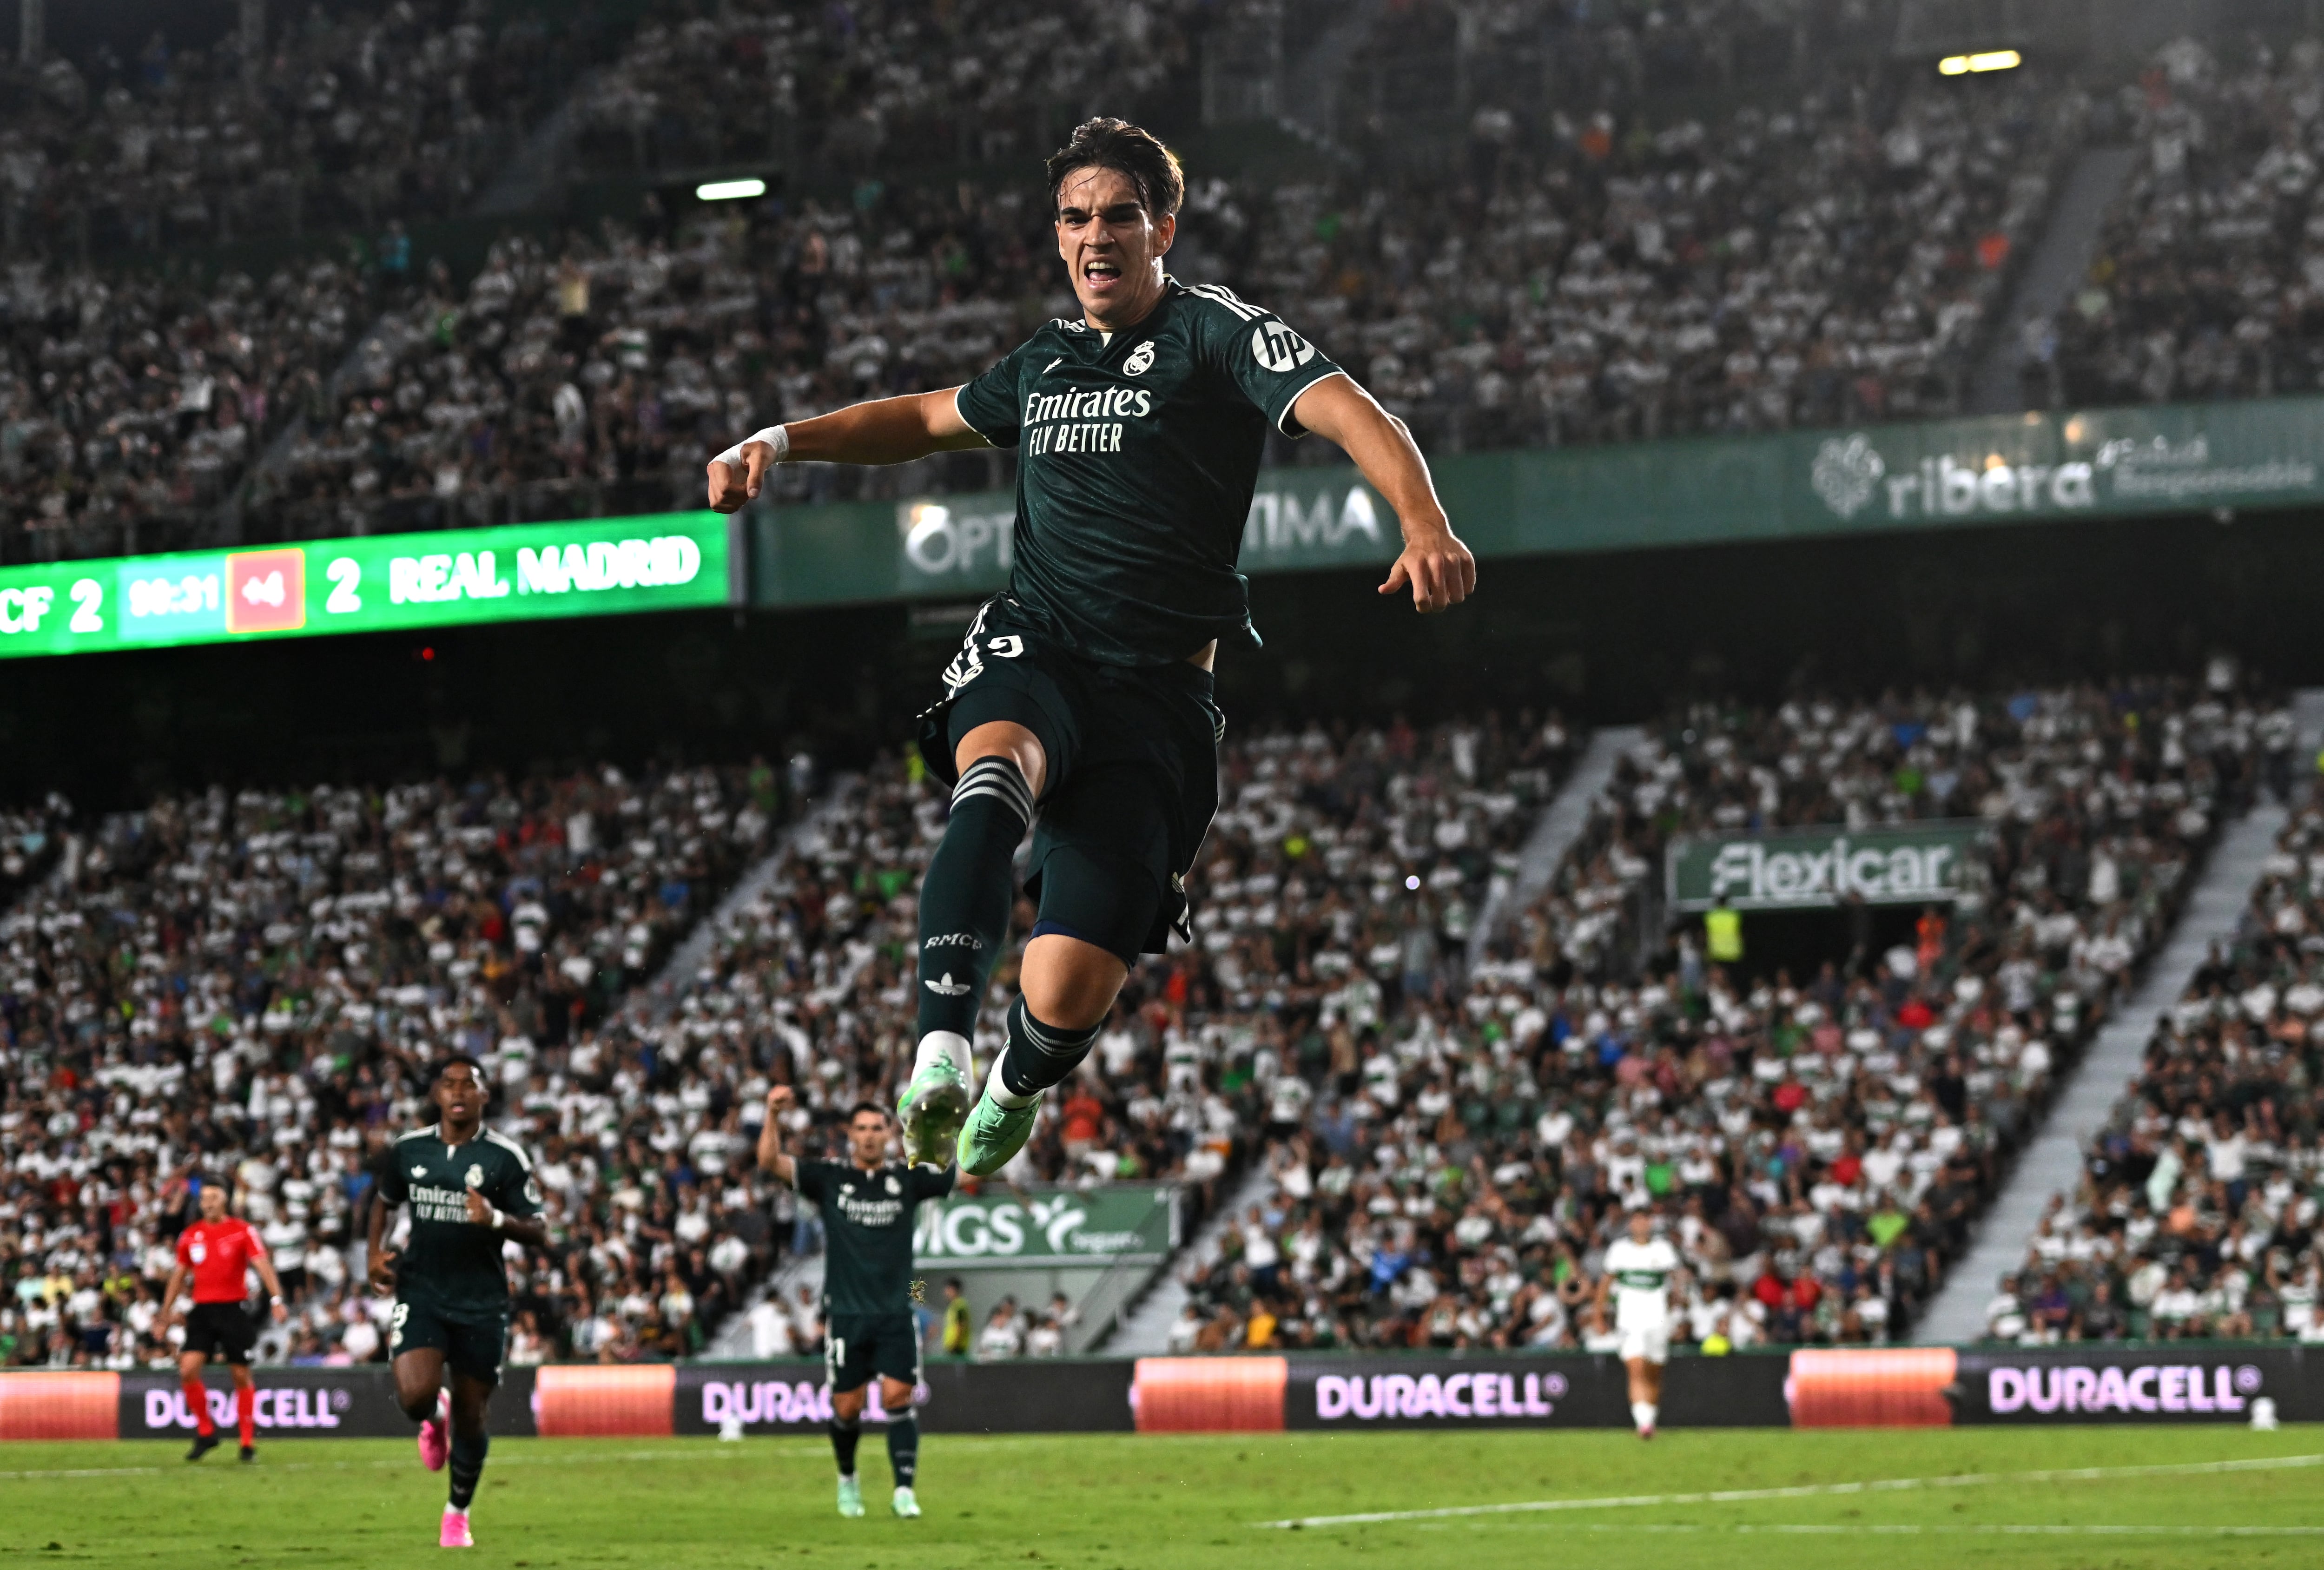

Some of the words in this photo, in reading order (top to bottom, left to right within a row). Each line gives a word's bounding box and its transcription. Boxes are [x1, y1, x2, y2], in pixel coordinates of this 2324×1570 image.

[1258, 321, 1306, 371] hp
[1024, 384, 1151, 428] Emirates
[1029, 425, 1054, 457] FLY
[1054, 423, 1123, 452] BETTER
[1885, 453, 2094, 518] ribera
[0, 586, 54, 634] CF
[70, 579, 103, 633] 2
[326, 557, 361, 614] 2
[390, 550, 510, 604] REAL
[517, 534, 701, 596] MADRID
[1710, 838, 1952, 901] Flexicar
